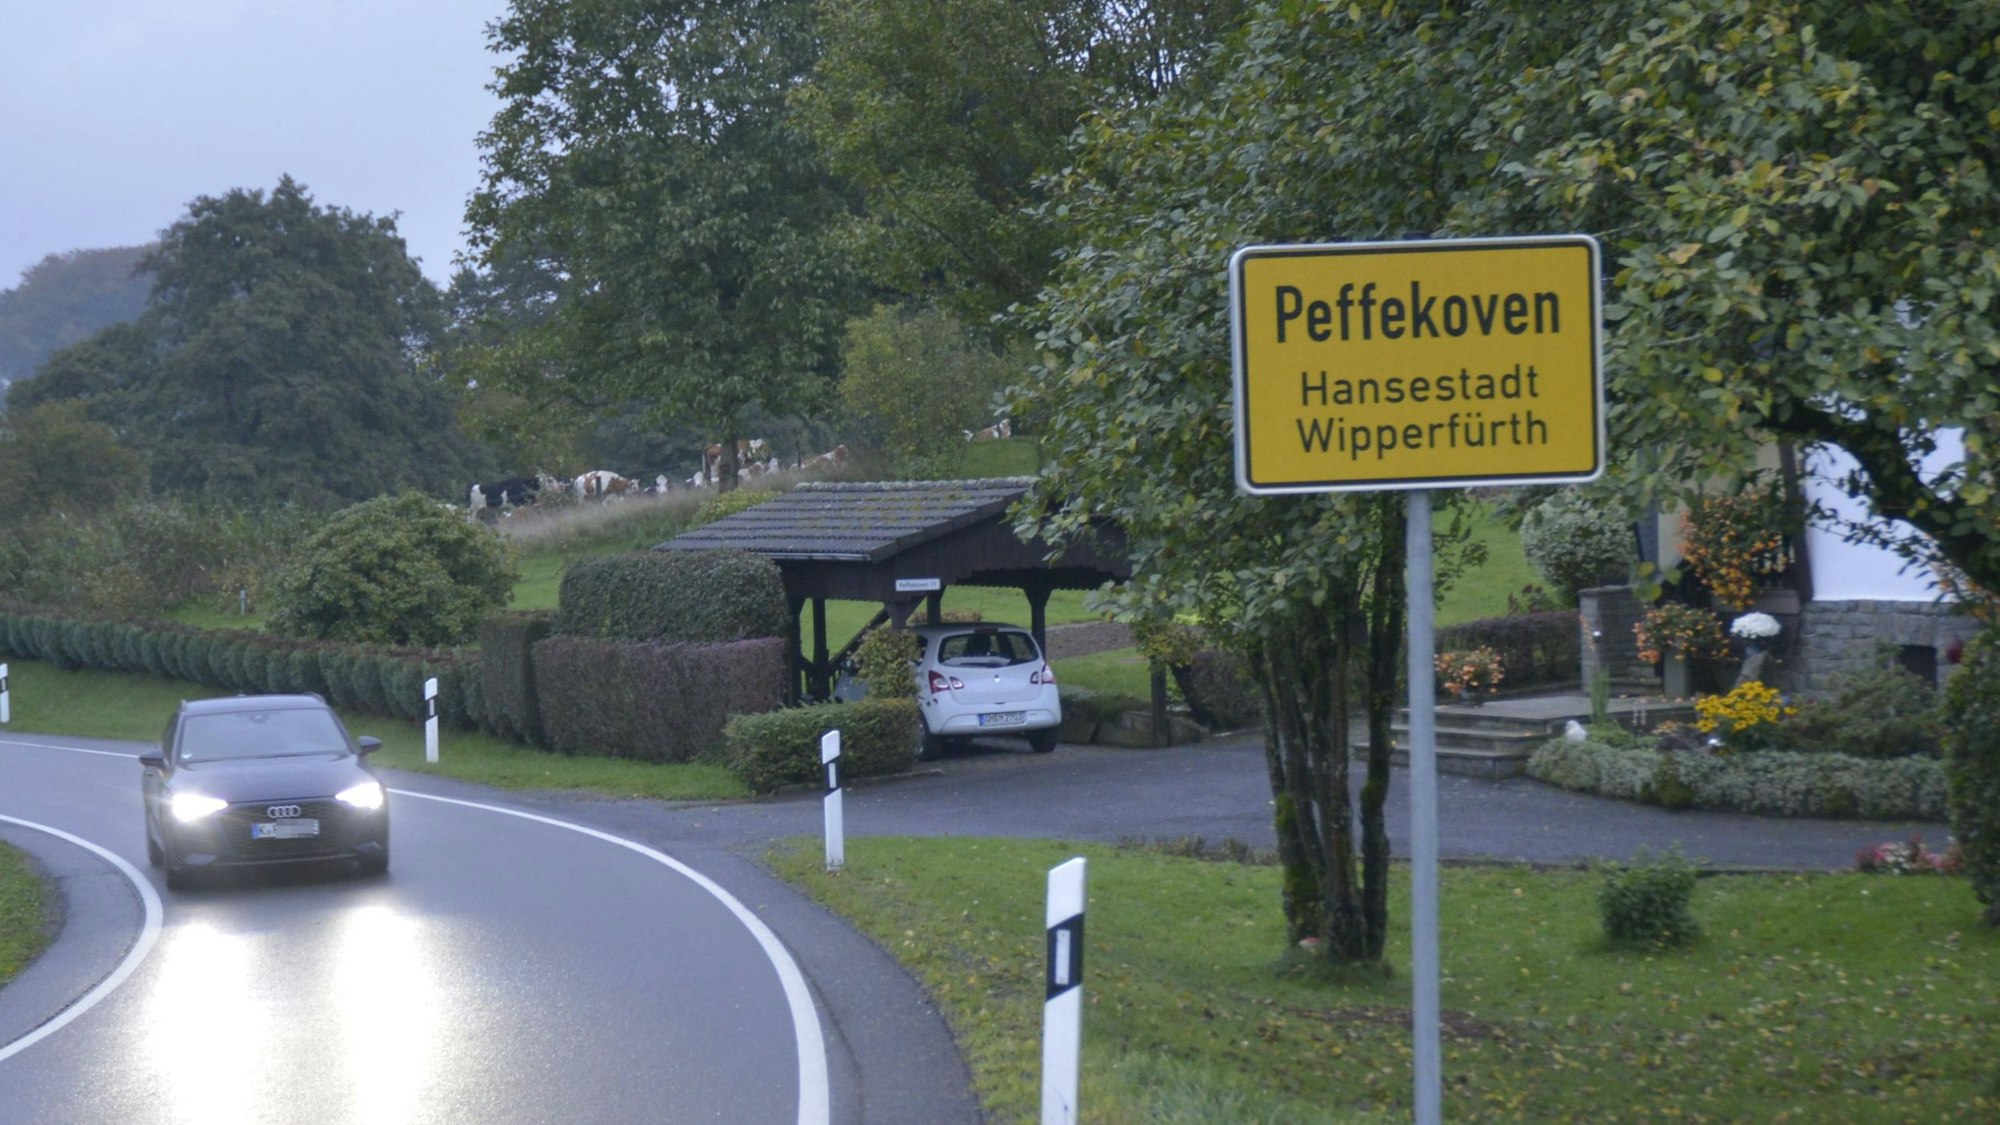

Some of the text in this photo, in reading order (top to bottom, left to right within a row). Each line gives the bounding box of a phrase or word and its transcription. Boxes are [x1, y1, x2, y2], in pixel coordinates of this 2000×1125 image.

[1275, 281, 1560, 343] Peffekoven
[1301, 363, 1539, 406] Hansestadt
[1296, 409, 1548, 461] Wipperfürth
